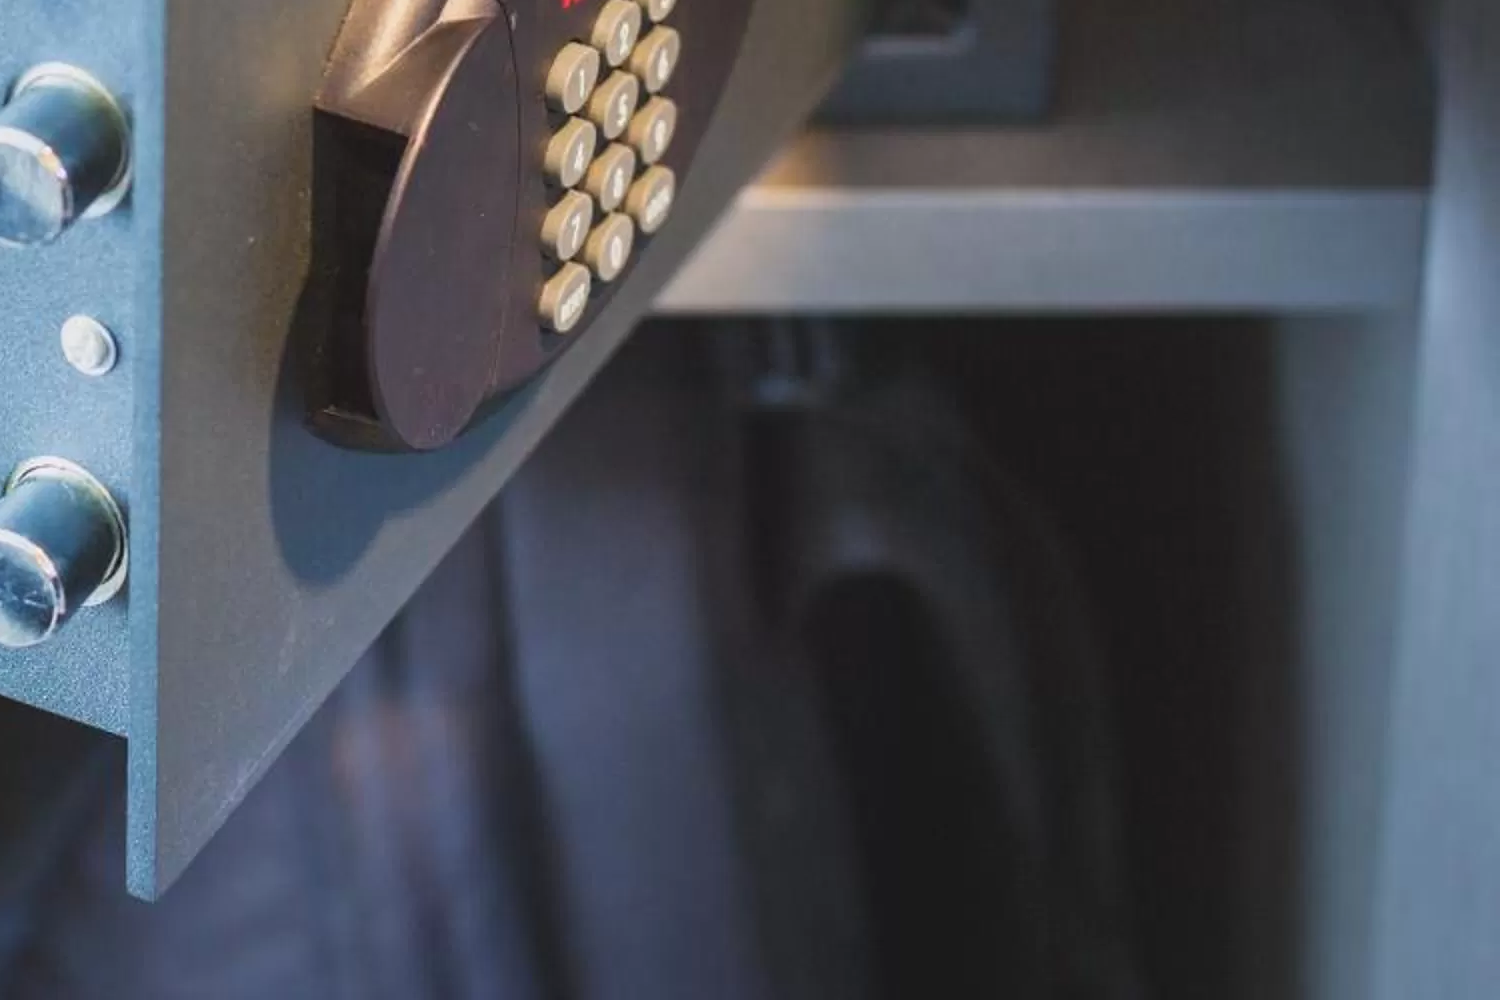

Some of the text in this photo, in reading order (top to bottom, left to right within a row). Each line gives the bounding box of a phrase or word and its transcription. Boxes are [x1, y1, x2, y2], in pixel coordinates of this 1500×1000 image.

[618, 21, 630, 57] 2
[617, 92, 629, 128] 5
[573, 140, 585, 171] 4
[612, 166, 624, 200] 8
[571, 212, 581, 250] 7
[610, 234, 623, 270] 0
